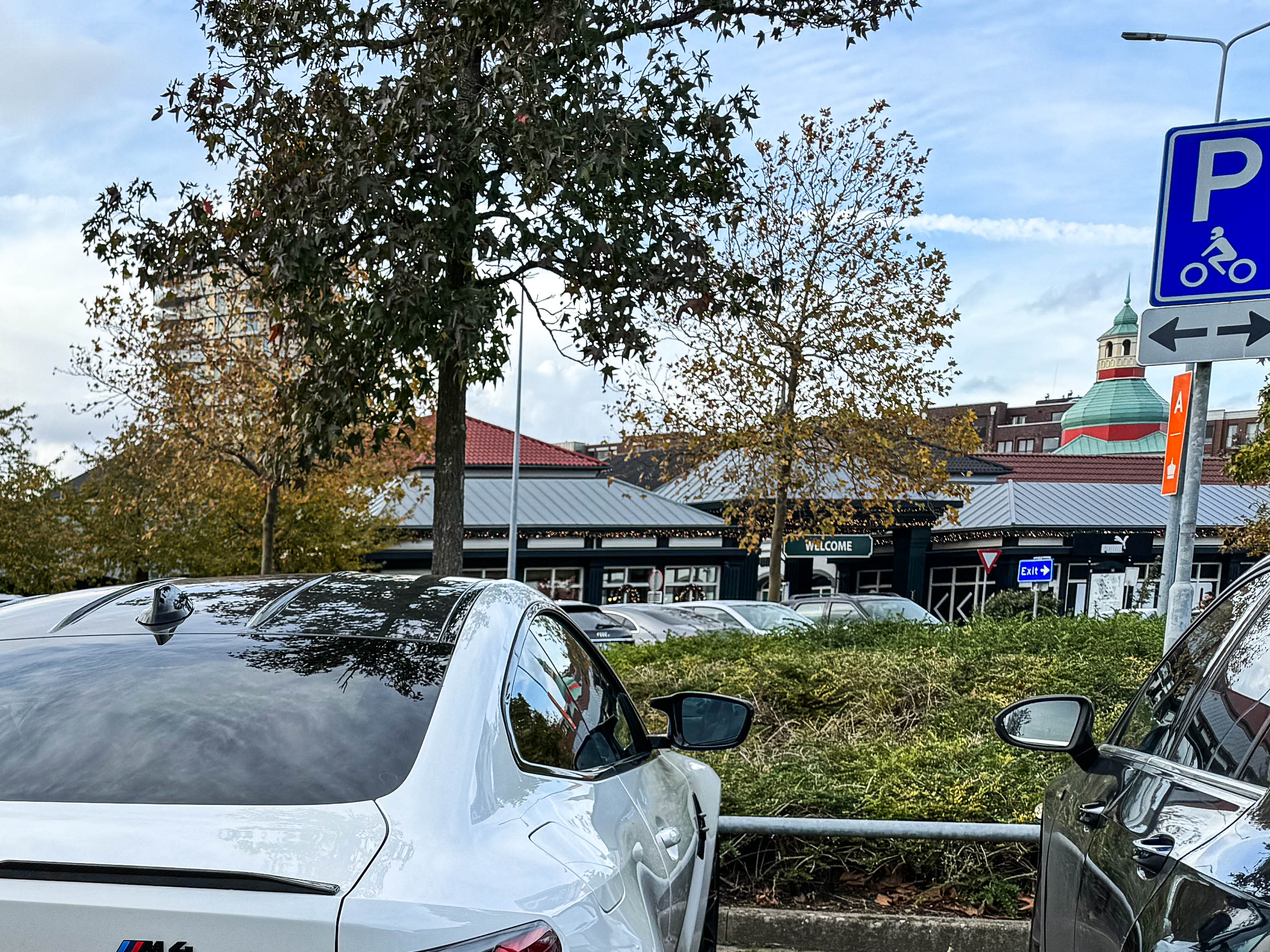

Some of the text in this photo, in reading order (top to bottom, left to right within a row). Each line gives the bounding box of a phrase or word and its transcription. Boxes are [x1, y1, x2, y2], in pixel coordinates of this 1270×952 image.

[1192, 137, 1263, 222] P
[1174, 391, 1183, 414] A
[1021, 566, 1038, 576] Exit
